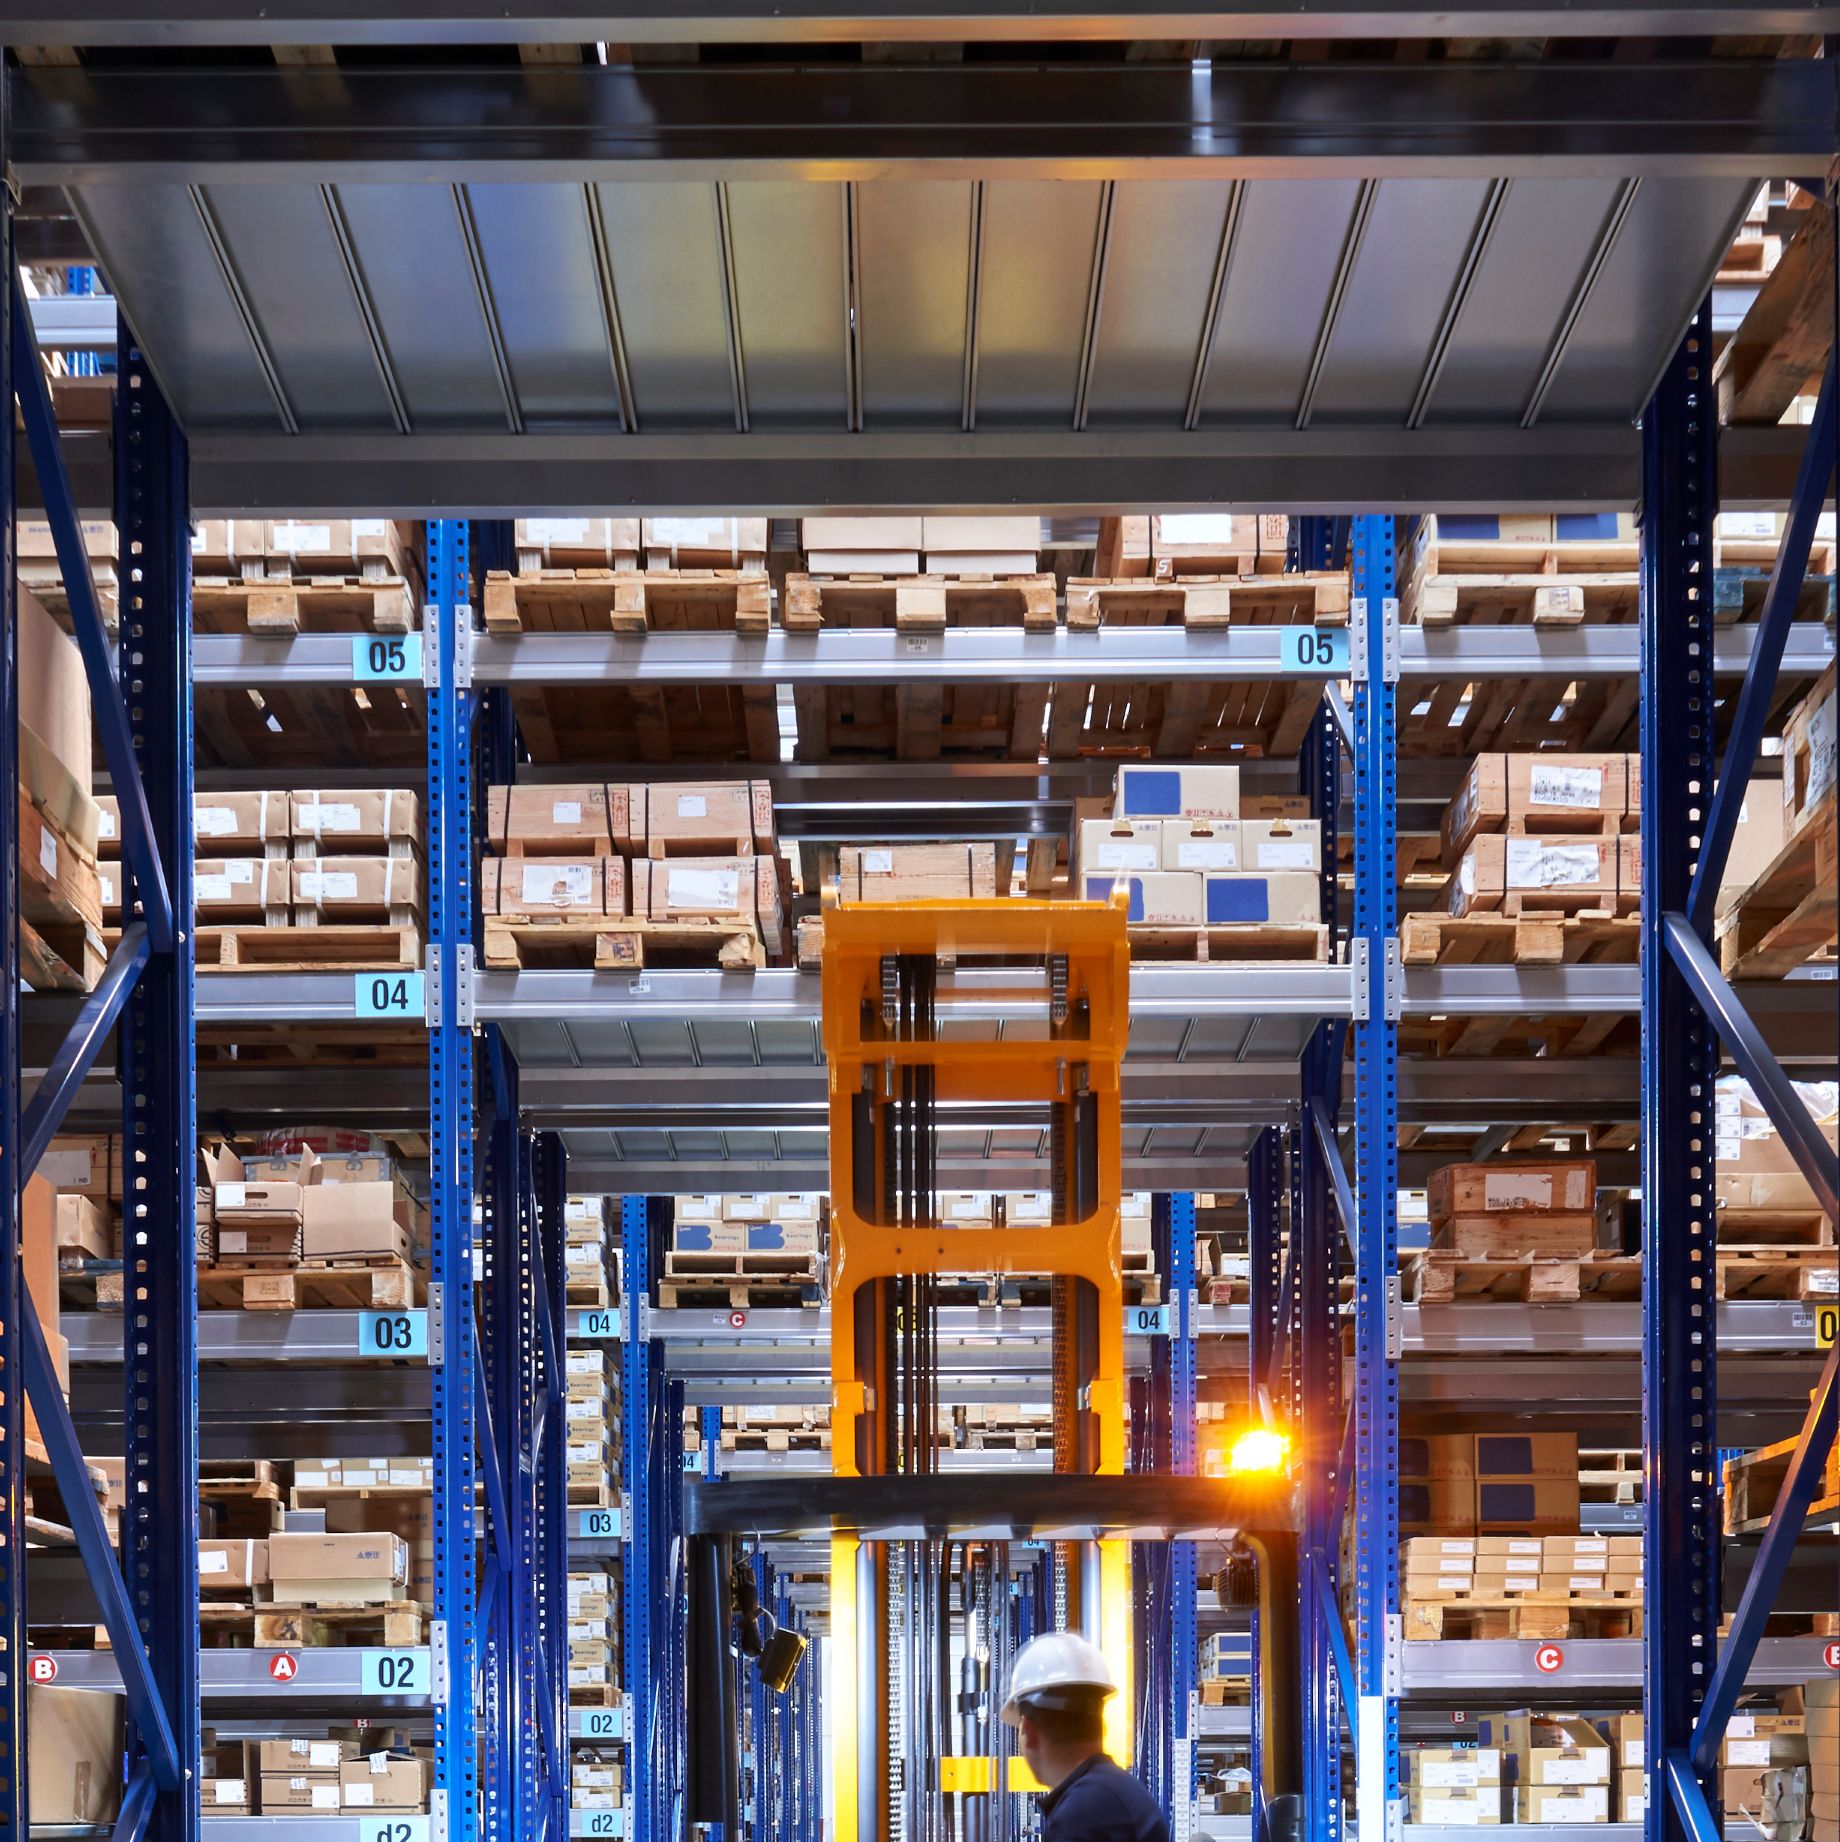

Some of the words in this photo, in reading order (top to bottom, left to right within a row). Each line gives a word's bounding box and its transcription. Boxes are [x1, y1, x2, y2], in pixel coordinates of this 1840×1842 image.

[369, 642, 406, 673] 05
[1297, 634, 1334, 665] 05
[372, 979, 408, 1010] 04
[589, 1314, 610, 1333] 04
[731, 1314, 743, 1327] C
[1138, 1311, 1160, 1330] 04
[375, 1318, 412, 1349] 03
[590, 1514, 611, 1533] 03
[35, 1659, 53, 1679] B
[273, 1658, 292, 1677] A
[1540, 1650, 1558, 1669] C
[379, 1657, 414, 1688] 02
[591, 1714, 613, 1733] 02
[1454, 1711, 1465, 1723] B
[592, 1814, 613, 1833] d2
